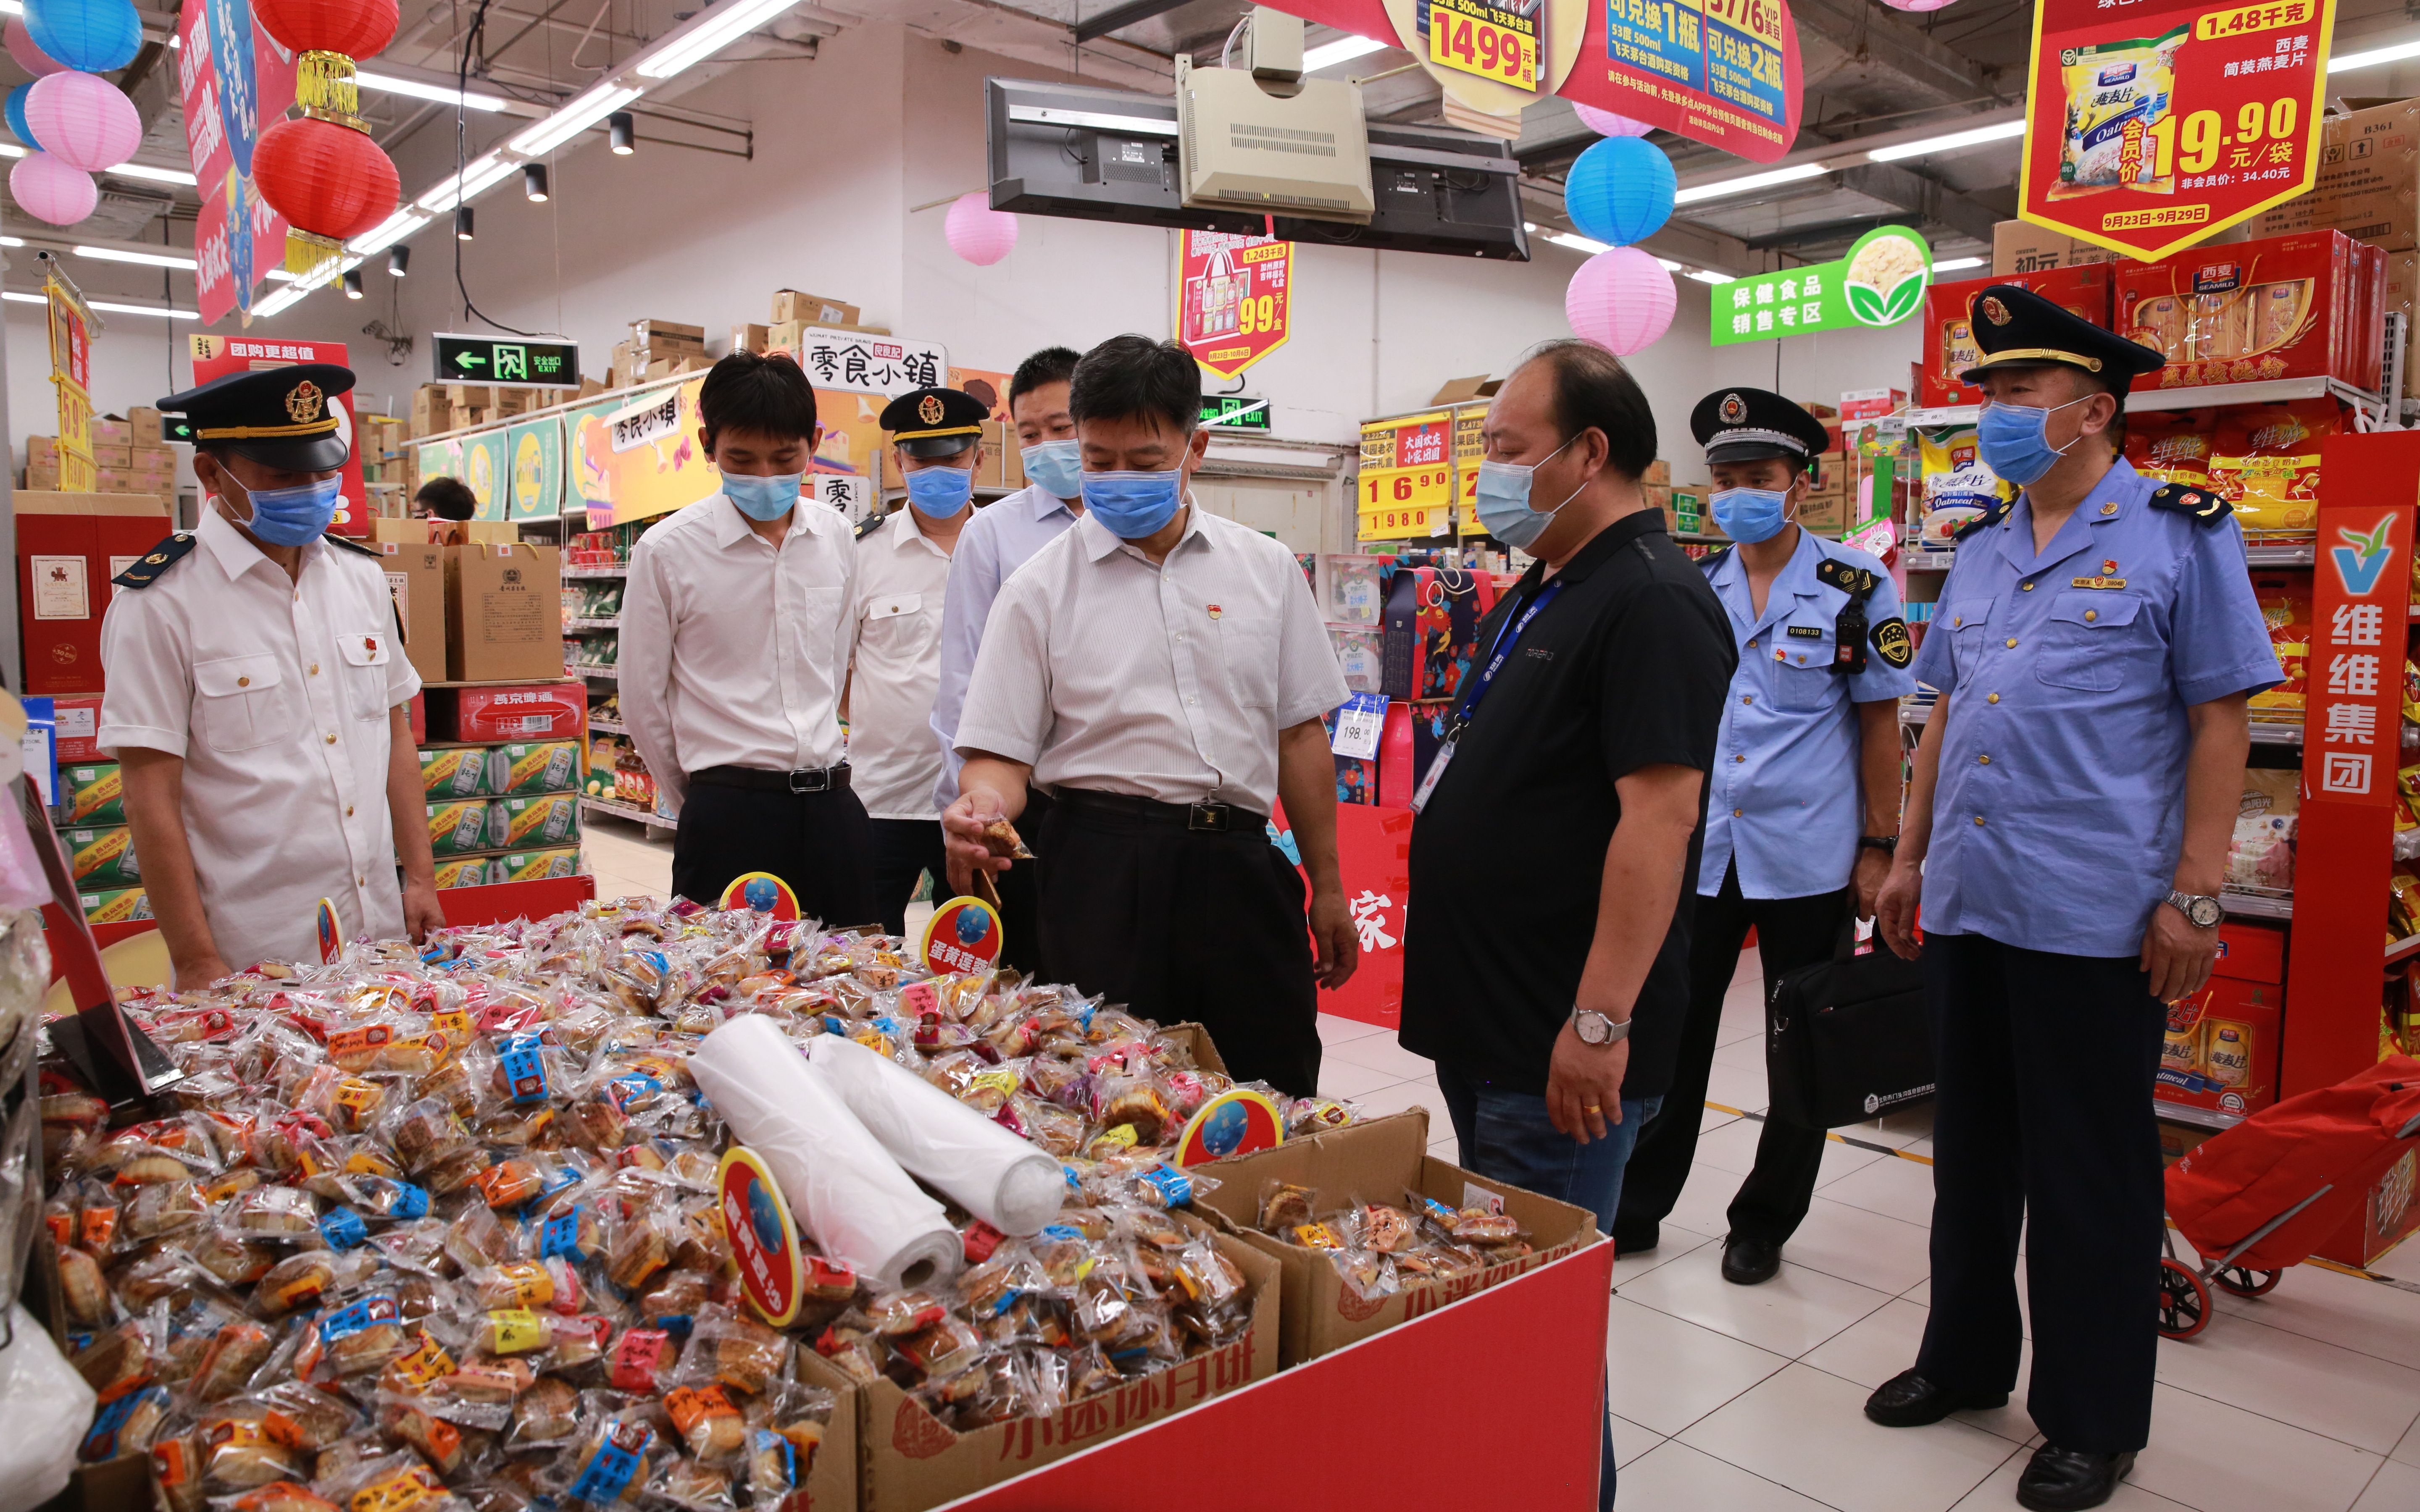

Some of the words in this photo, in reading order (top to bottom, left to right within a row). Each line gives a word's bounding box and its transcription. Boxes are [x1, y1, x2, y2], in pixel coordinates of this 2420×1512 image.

[1458, 0, 1488, 19] 500ml
[1490, 8, 1533, 34] 飞天茅台酒
[1764, 5, 1778, 21] VIP
[2206, 3, 2306, 36] 1.48千克
[1612, 23, 1632, 43] 53度
[1634, 32, 1661, 52] 500ml
[1765, 20, 1781, 42] 美豆
[1434, 12, 1521, 76] 1499
[2275, 35, 2309, 53] 西麦
[1612, 39, 1689, 81] 飞天茅台酒购买资格
[1707, 27, 1783, 91] 可兑换2瓶
[2223, 52, 2308, 78] 简装燕麦片
[1711, 62, 1727, 81] 53度
[1729, 70, 1751, 89] 500ml
[2104, 75, 2130, 84] SEAMILD
[1711, 79, 1773, 116] 飞天茅台酒购买资格
[1689, 116, 1725, 136] 活动详见店内公告
[2364, 121, 2393, 135] B361
[2146, 97, 2299, 178] 19.90
[2119, 118, 2144, 183] 会员价
[2229, 142, 2294, 168] 元/袋
[2104, 207, 2207, 228] 9月23日-9月29日
[1245, 247, 1284, 262] 1.243千克
[2015, 253, 2059, 274] 初元
[2202, 264, 2232, 279] 西麦
[1271, 278, 1284, 289] 礼盒
[1733, 275, 1821, 309] 保健食品
[2199, 281, 2234, 291] SEAMILD
[1240, 295, 1274, 335] 99
[1733, 302, 1822, 334] 销售专区
[230, 342, 316, 361] 团购更超值
[533, 355, 561, 367] 安全出口
[1209, 349, 1249, 361] 9月23日-10月6日
[538, 365, 558, 373] EXIT
[811, 344, 939, 390] 零食小镇
[2160, 355, 2288, 388] 燕麦核桃粉
[1245, 412, 1263, 423] EXIT
[1405, 432, 1442, 450] 大国欢庆
[1457, 433, 1483, 446] 果园老
[2253, 421, 2304, 449] 维维
[1361, 442, 1394, 455] 果园老农
[1457, 447, 1482, 457] 富贵团圆
[1953, 448, 1973, 460] 西麦
[2151, 436, 2201, 461] 维维
[2241, 457, 2301, 467] 维他型豆奶粉
[826, 479, 852, 512] 零
[1934, 498, 1973, 507] Oatmeal
[1526, 648, 1554, 661] TOREAD
[494, 691, 552, 705] 燕京啤酒
[2323, 604, 2383, 795] 维维集团
[434, 755, 458, 773] 燕京啤酒
[526, 750, 549, 767] 燕京啤酒
[97, 777, 121, 795] 燕京啤
[526, 803, 549, 821] 燕京啤酒
[2241, 798, 2271, 811] 澳阳光
[435, 809, 459, 828] 燕京啤酒
[95, 832, 126, 855] 燕京啤酒
[526, 859, 549, 877] 燕京啤酒
[102, 898, 132, 919] 燕京啤酒
[1350, 890, 1397, 953] 家
[929, 939, 989, 976] 蛋黄莲蓉
[2210, 1050, 2248, 1069] 燕麦片
